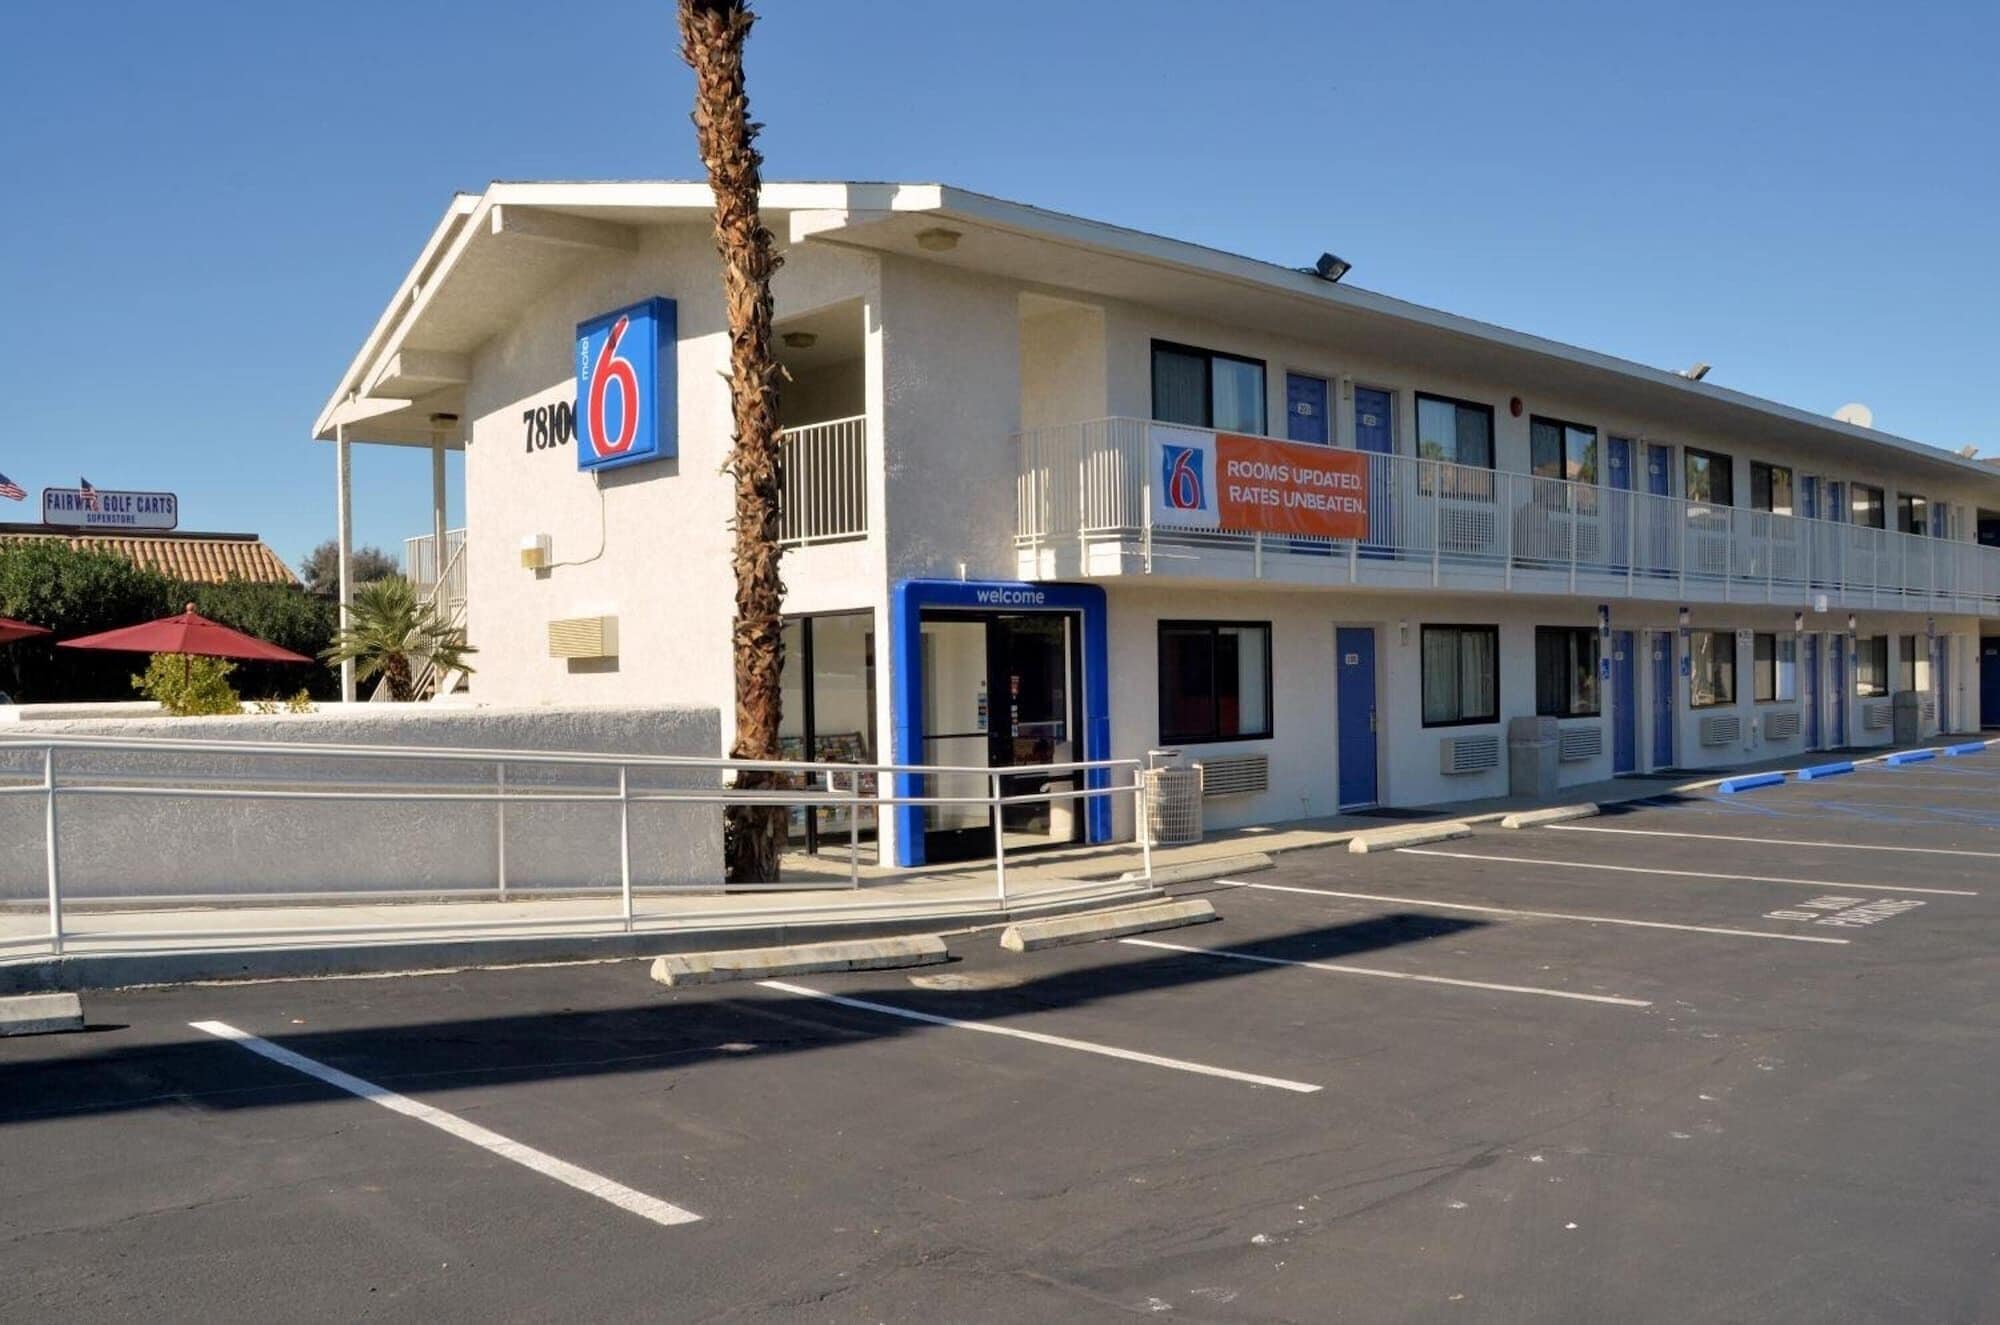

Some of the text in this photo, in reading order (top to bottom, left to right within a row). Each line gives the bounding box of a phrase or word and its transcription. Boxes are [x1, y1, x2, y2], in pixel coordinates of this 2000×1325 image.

[581, 337, 590, 381] motel
[588, 314, 639, 457] 6
[523, 399, 577, 453] 7810
[1169, 448, 1200, 511] 6
[1227, 460, 1363, 490] ROOMS UPDATED.
[103, 495, 132, 512] GOLF
[137, 497, 173, 514] CARTS
[1229, 485, 1367, 514] RATES UNBEATEN.
[87, 513, 136, 525] SUPERSTORE
[976, 588, 1045, 604] welcome
